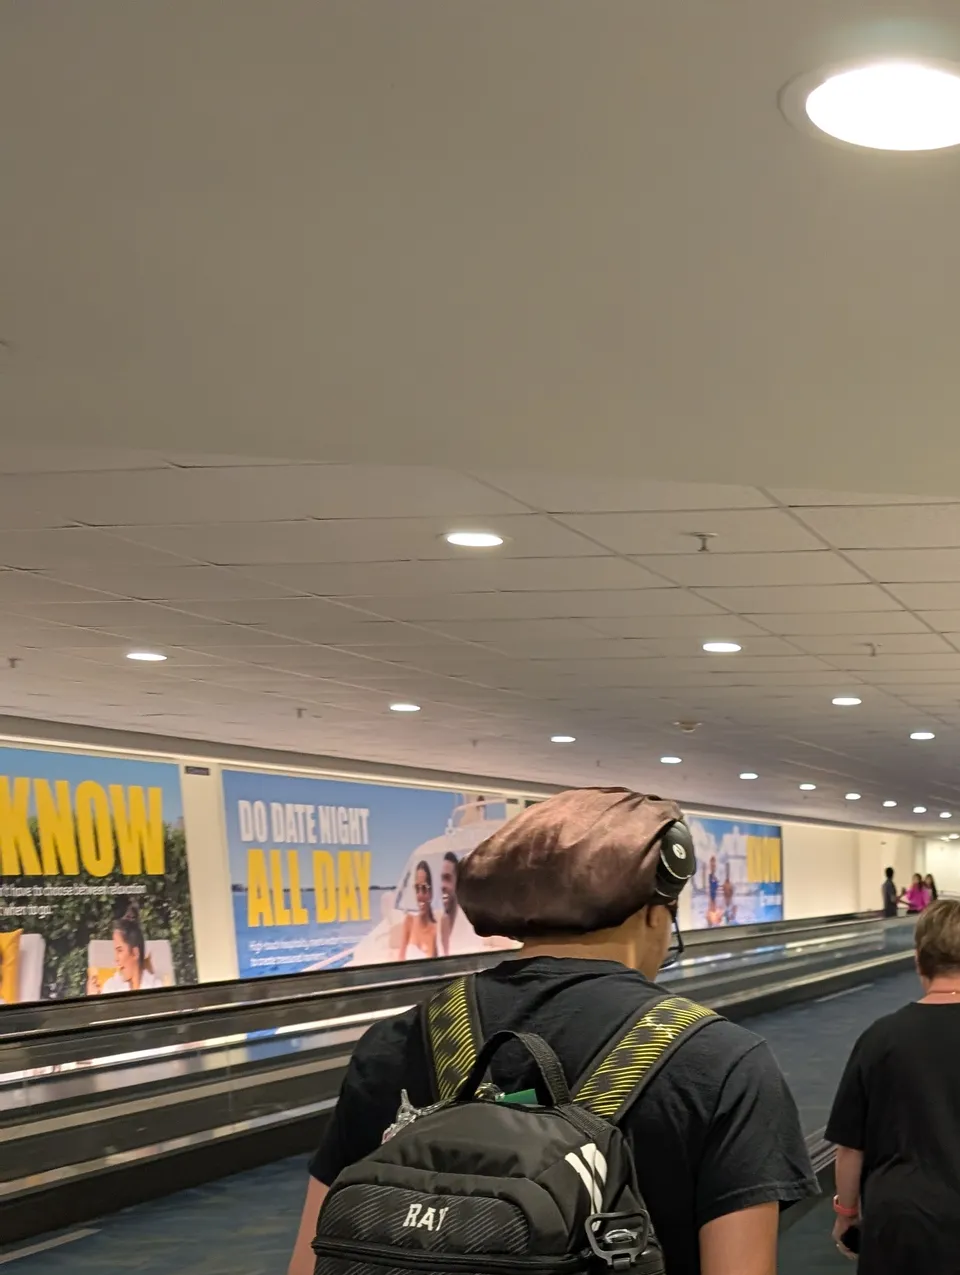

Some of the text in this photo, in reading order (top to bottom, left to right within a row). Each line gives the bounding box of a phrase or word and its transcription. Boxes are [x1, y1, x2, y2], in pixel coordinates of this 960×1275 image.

[0, 775, 165, 877] KNOW
[238, 800, 370, 845] DO DATE NIGHT
[247, 849, 372, 927] ALL DAY
[402, 1203, 449, 1231] RAY
